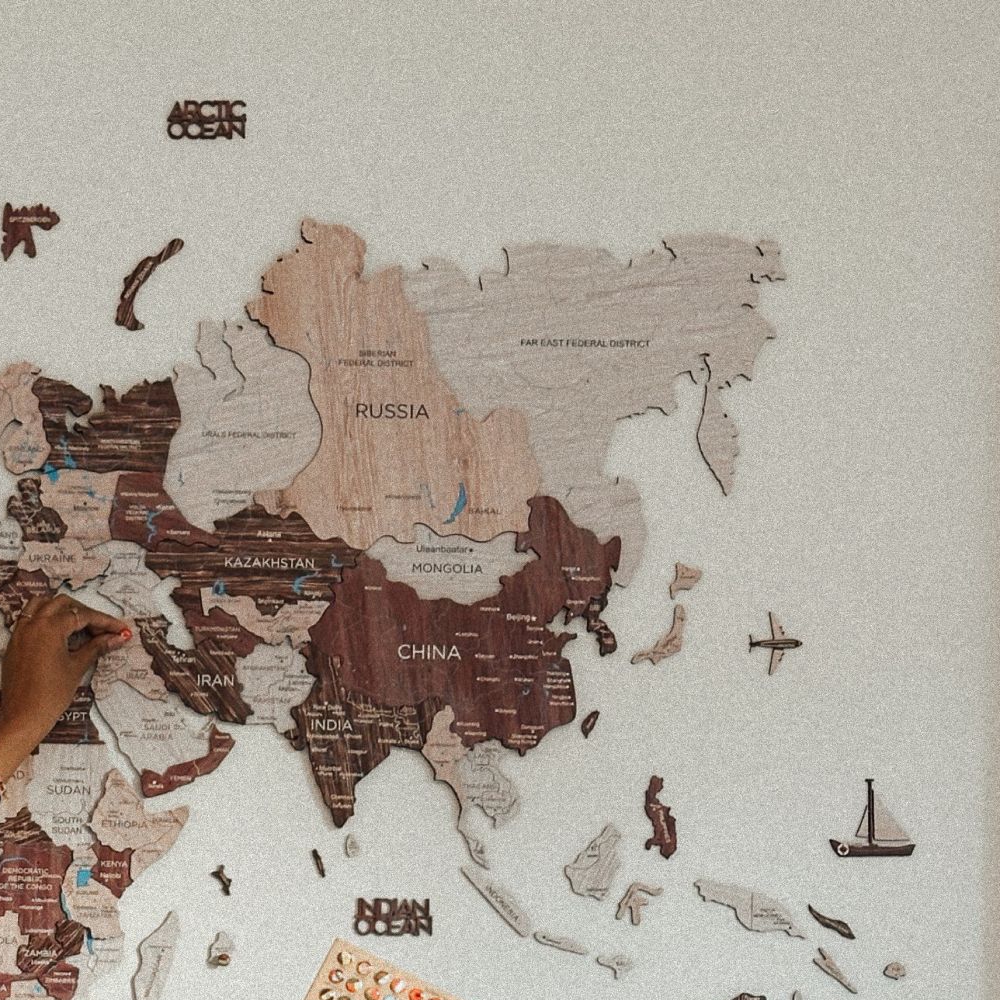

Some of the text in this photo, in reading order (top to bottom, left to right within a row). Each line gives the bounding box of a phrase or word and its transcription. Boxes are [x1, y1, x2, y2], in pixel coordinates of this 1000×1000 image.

[167, 100, 247, 122] ARCTIC
[167, 121, 246, 140] OCEAN
[521, 339, 650, 348] FAR EAST FEDERAL DISTRICT
[338, 359, 375, 367] FEDERAL
[356, 403, 430, 419] RUSSIA
[29, 554, 76, 563] UKRAINE
[224, 557, 315, 569] KAZAKHSTAN
[412, 564, 483, 574] MONGOLIA
[398, 644, 461, 660] CHINA
[197, 674, 234, 687] IRAN
[311, 719, 353, 731] INDIA
[46, 785, 91, 795] SUDAN
[354, 916, 433, 936] OCEAN
